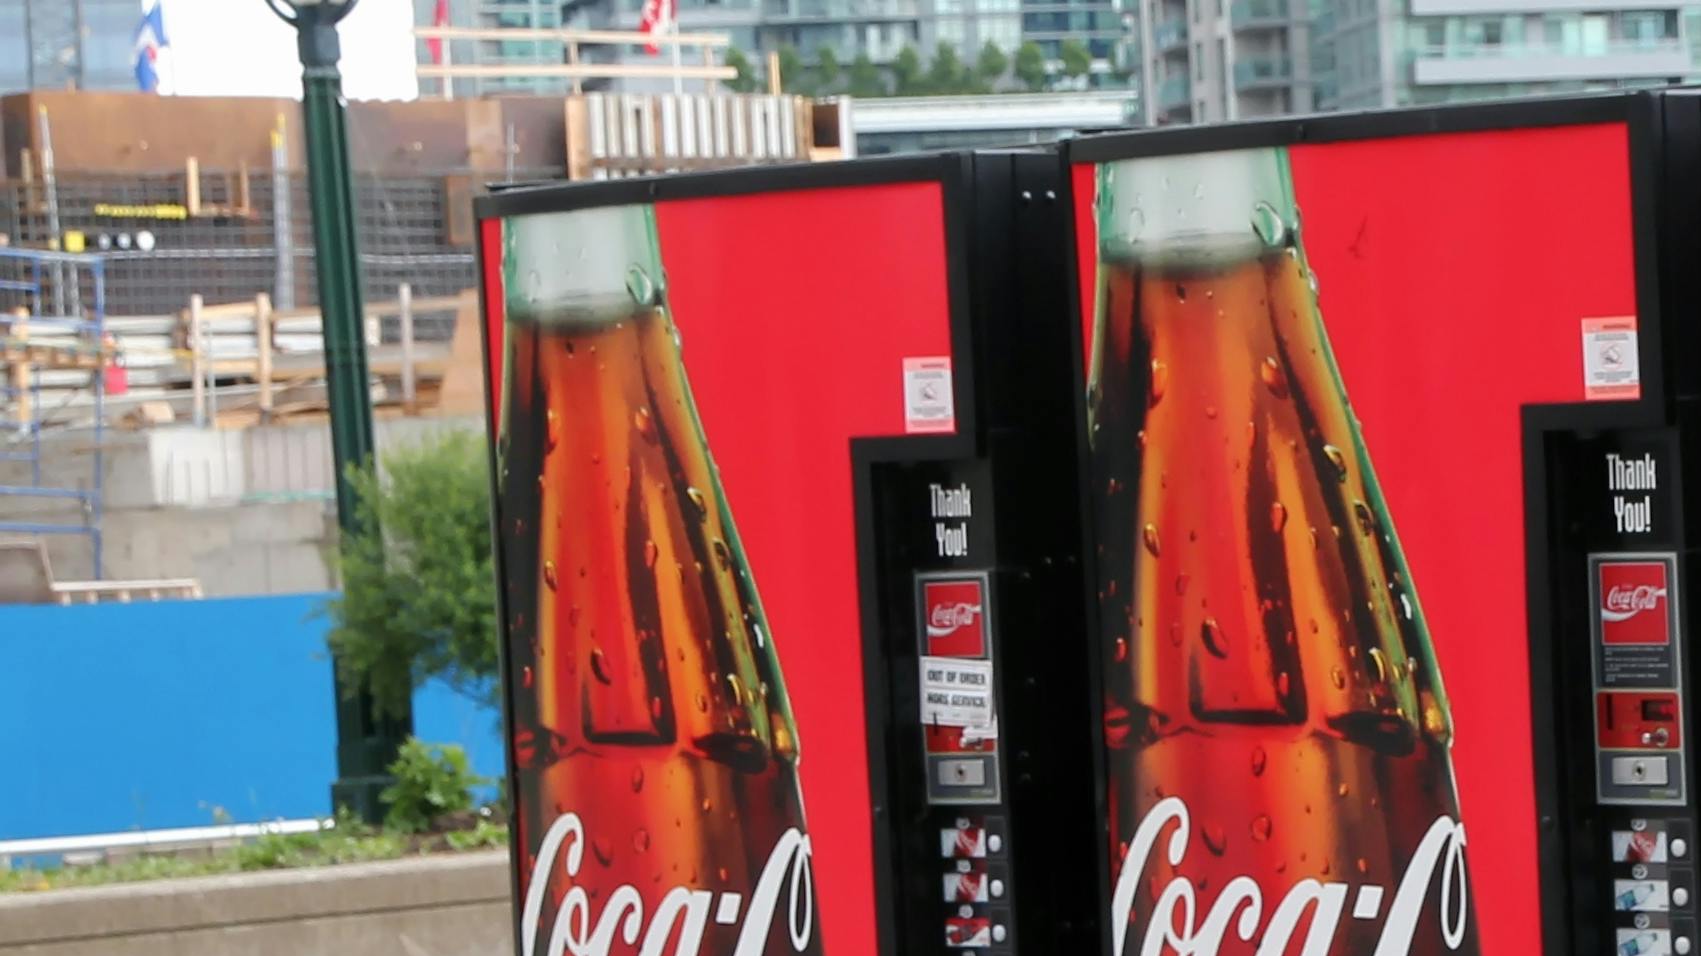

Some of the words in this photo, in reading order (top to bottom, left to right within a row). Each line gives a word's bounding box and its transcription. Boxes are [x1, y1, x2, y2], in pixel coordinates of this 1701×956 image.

[1605, 452, 1657, 491] Thank
[929, 483, 972, 518] Thank
[1613, 495, 1652, 534] You!
[935, 522, 969, 558] You!
[928, 671, 943, 681] OUT
